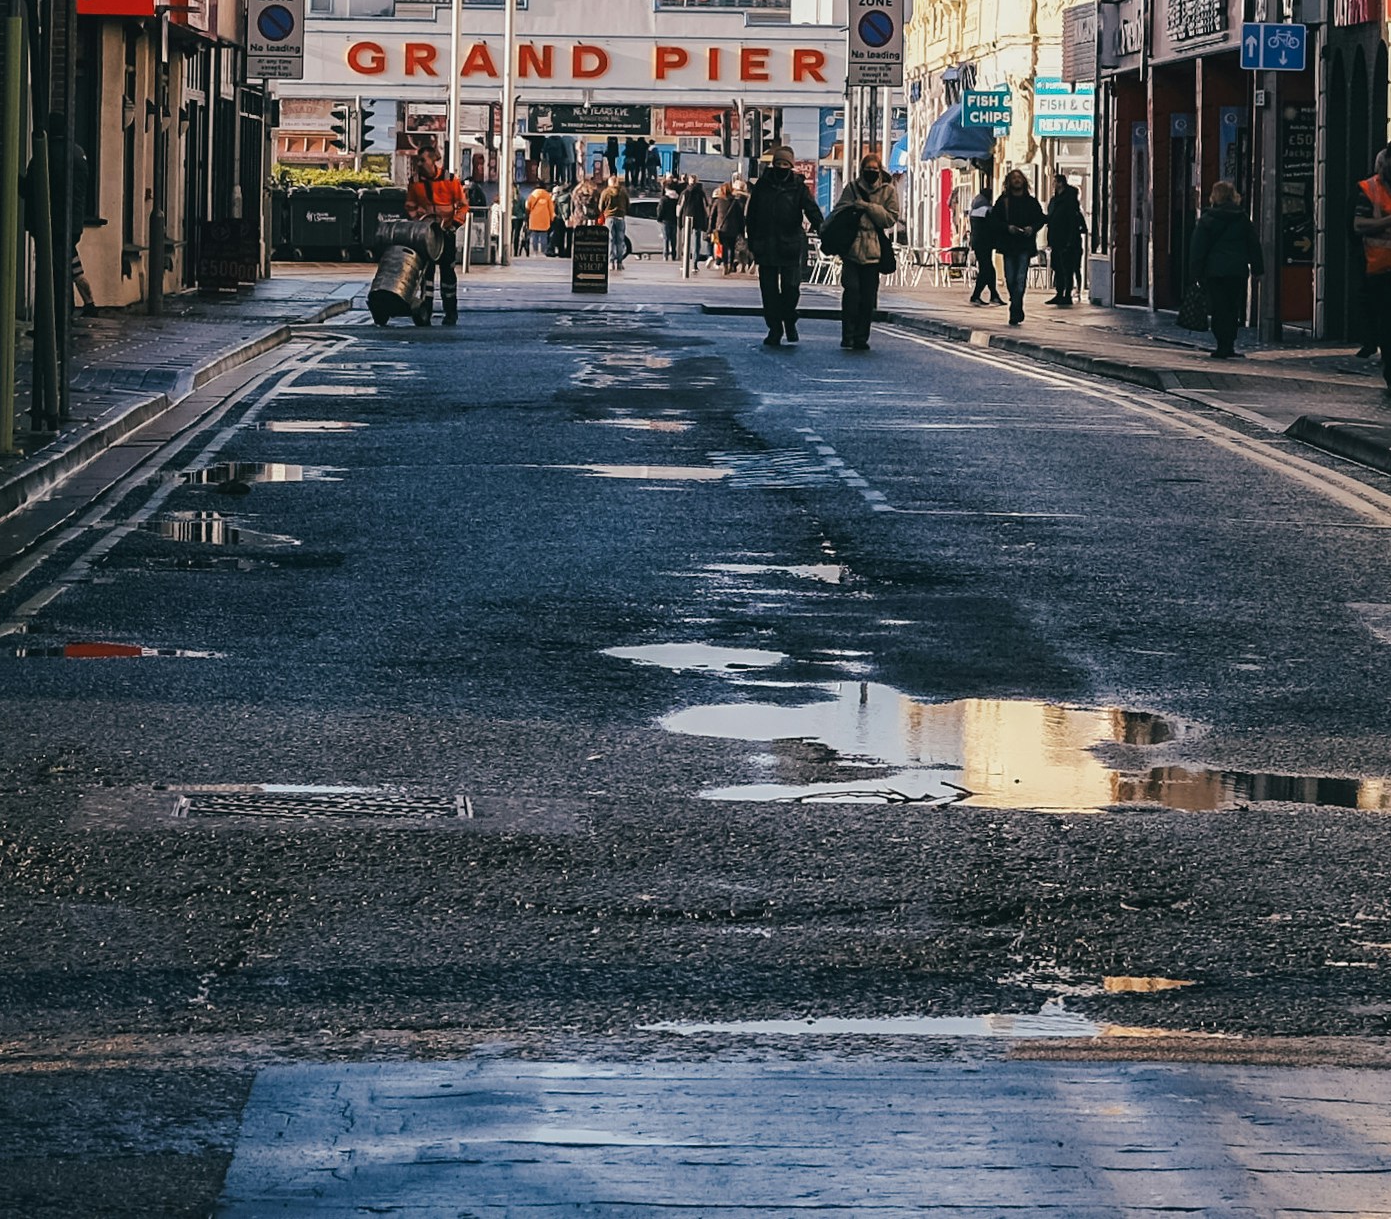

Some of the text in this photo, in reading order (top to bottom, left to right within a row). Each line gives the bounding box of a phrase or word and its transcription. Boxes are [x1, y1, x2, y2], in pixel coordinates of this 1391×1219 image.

[250, 44, 301, 54] No loading
[851, 50, 900, 60] No loading
[346, 41, 828, 83] GRAND PIER
[968, 94, 1011, 107] FISH &
[1039, 99, 1066, 111] FISH
[1070, 99, 1078, 111] &
[969, 111, 1011, 123] CHIPS
[575, 253, 607, 262] SWEET
[578, 262, 605, 271] SHOP
